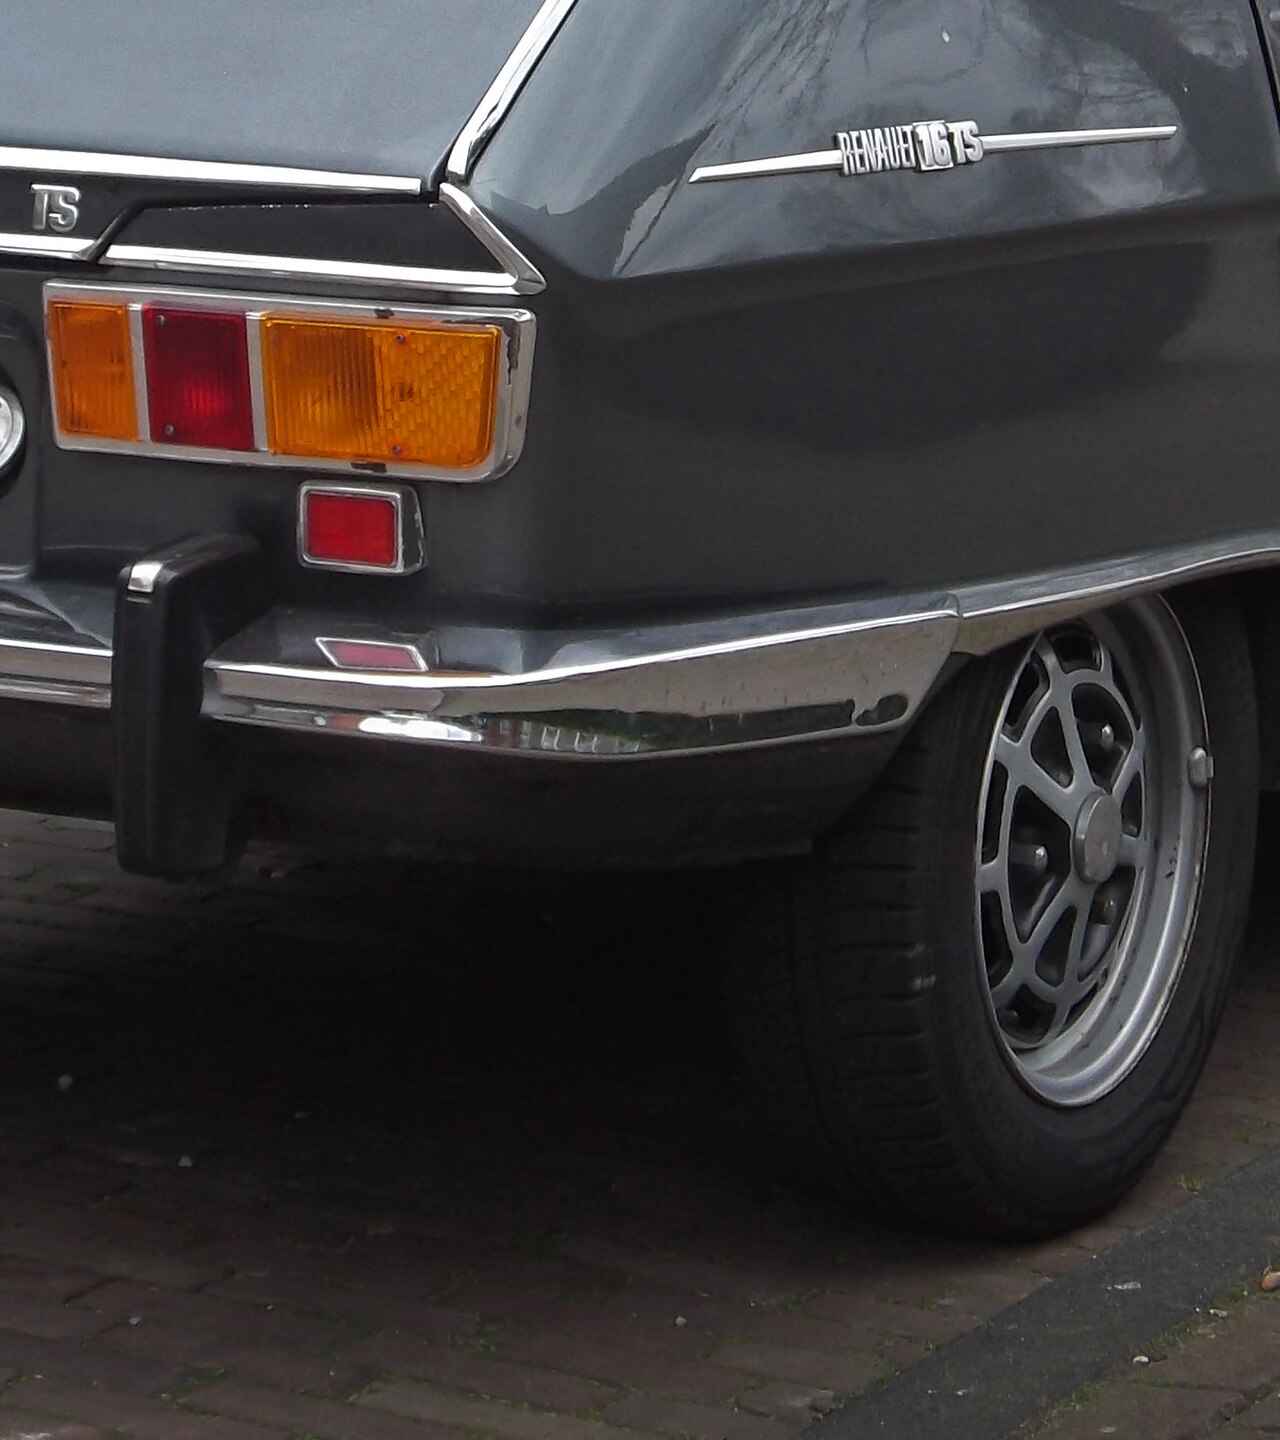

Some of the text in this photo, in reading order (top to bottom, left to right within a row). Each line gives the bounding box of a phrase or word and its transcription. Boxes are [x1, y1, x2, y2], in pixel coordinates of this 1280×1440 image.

[835, 120, 984, 176] RENAULT 16 TS
[30, 183, 80, 233] TS
